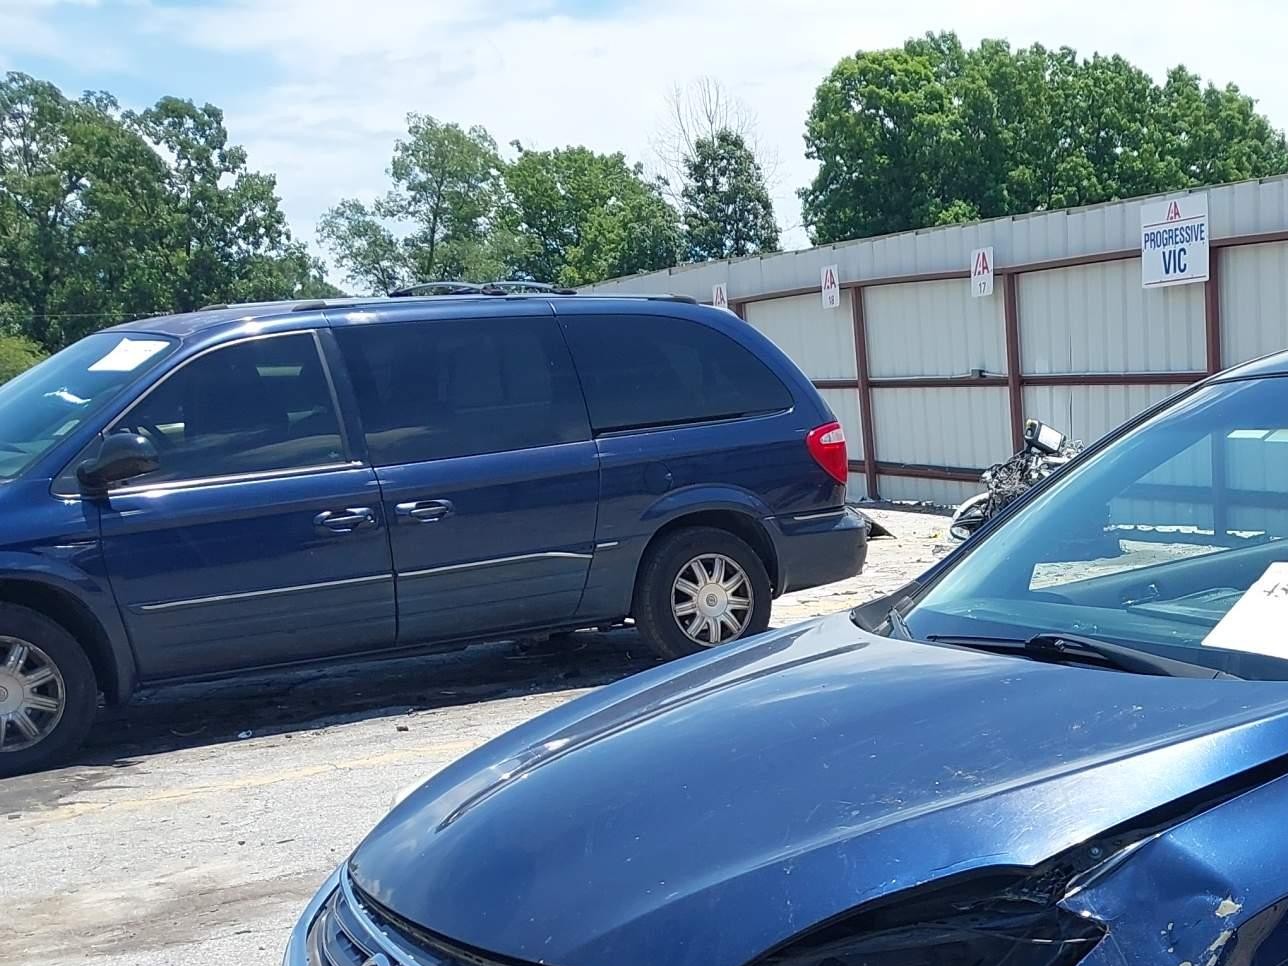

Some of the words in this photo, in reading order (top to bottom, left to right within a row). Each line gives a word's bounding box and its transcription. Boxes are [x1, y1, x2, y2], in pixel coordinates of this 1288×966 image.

[1144, 223, 1205, 250] PROGRESSIVE
[1162, 247, 1187, 274] VIC
[979, 281, 986, 294] 17
